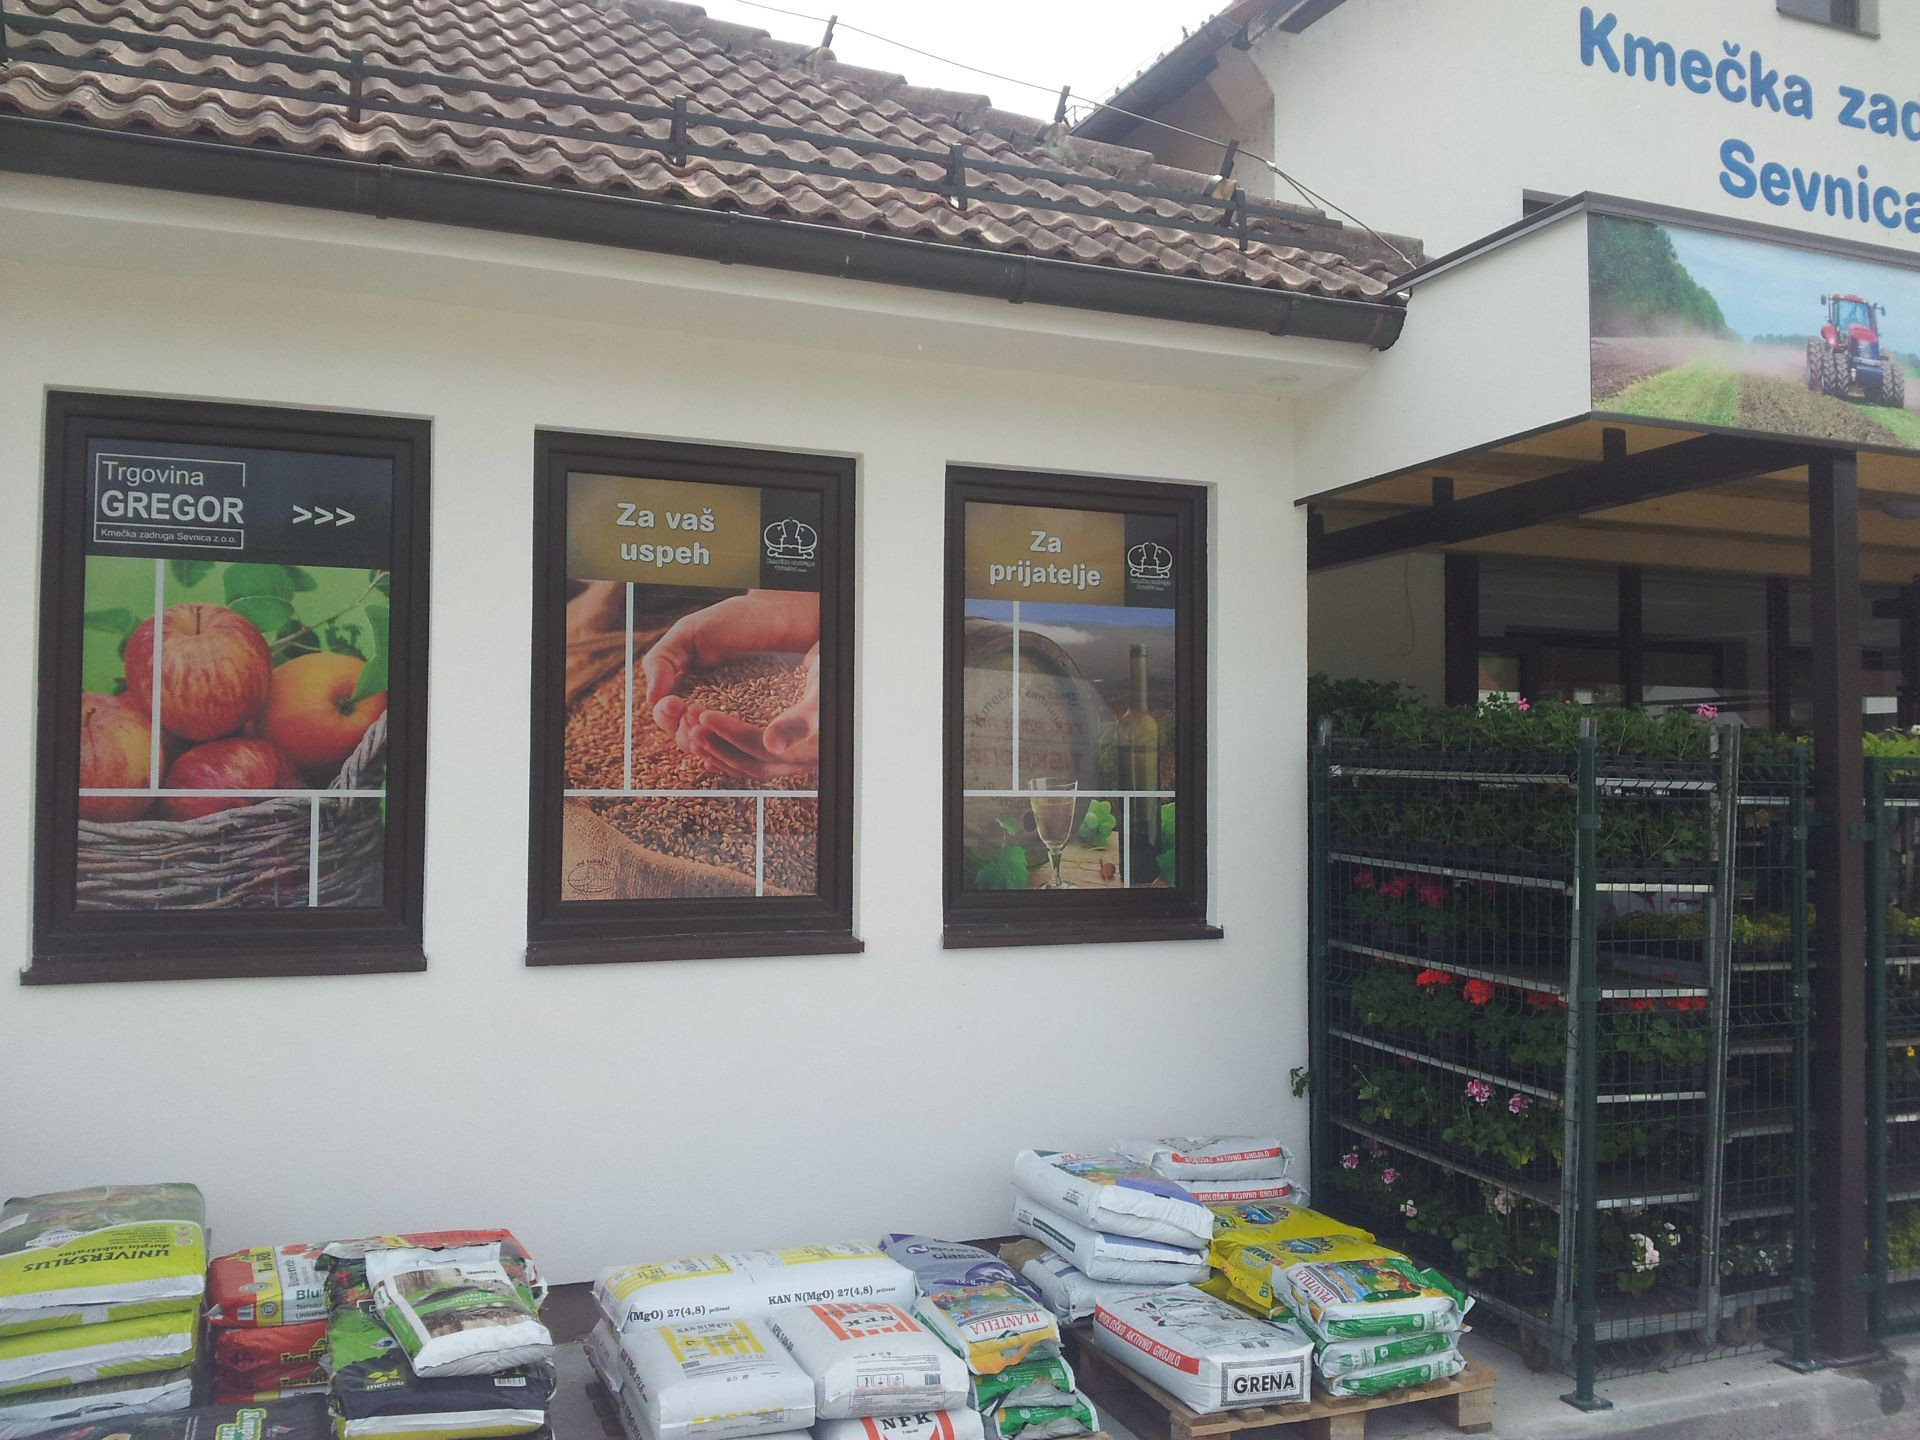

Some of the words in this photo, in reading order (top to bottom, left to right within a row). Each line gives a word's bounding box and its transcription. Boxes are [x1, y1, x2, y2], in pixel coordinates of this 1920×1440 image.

[1580, 6, 1813, 120] Kmečka
[1719, 138, 1920, 233] Sevnica
[102, 460, 204, 487] Trgovina
[101, 490, 244, 524] GREGOR
[616, 502, 655, 529] Za
[665, 507, 716, 532] vaš
[101, 528, 137, 540] Kmečka
[138, 531, 174, 543] zadruga
[177, 532, 211, 543] Sevnica
[1029, 530, 1062, 553] Za
[620, 541, 710, 568] uspeh
[989, 559, 1101, 590] prijatelje
[23, 1249, 170, 1273] UNIVERSALUS
[296, 1289, 325, 1300] Blu
[768, 1293, 792, 1306] KAN
[794, 1288, 835, 1304] N(MgO)
[837, 1285, 874, 1299] 27(4,8)
[667, 1304, 706, 1319] 27(4,8)
[970, 1312, 1041, 1335] PLANTELLA
[1099, 1311, 1126, 1337] BIOLOŠKO
[1126, 1325, 1153, 1352] AKTIVNO
[1153, 1343, 1182, 1368] GNOJILO
[1233, 1371, 1296, 1395] GRENA
[880, 1411, 933, 1431] NPK
